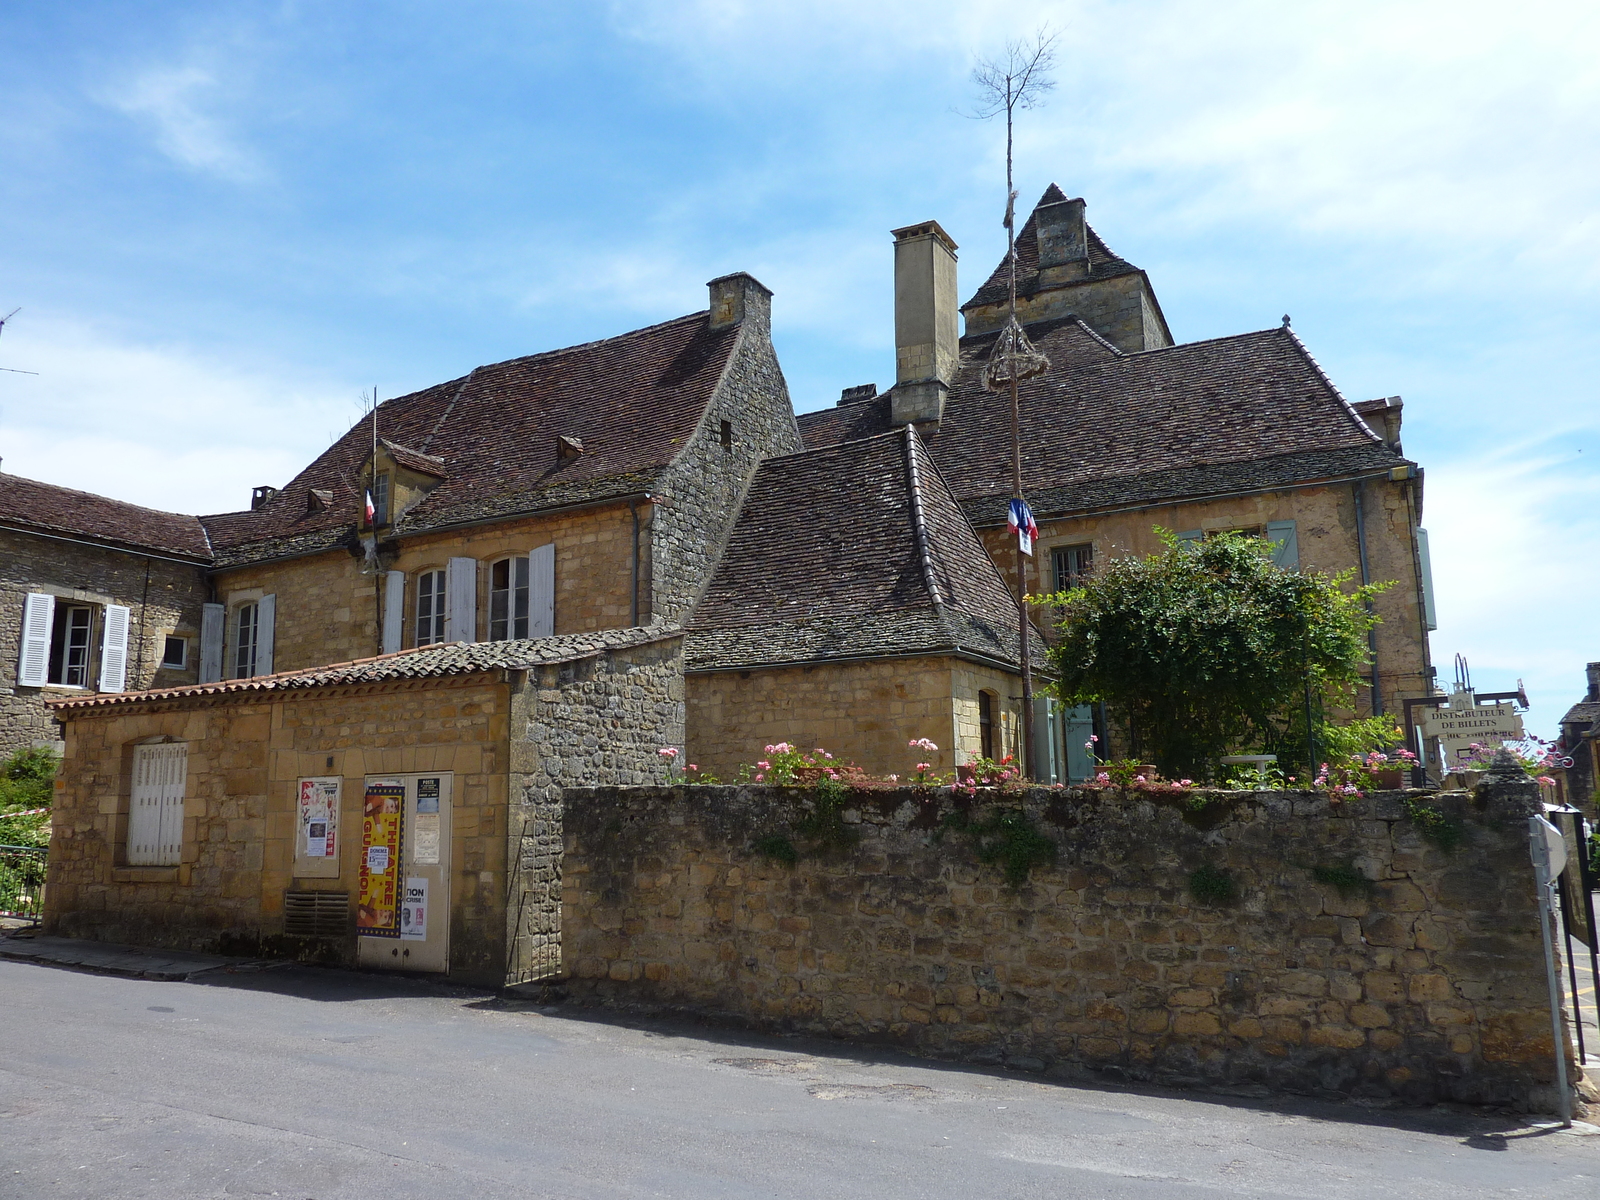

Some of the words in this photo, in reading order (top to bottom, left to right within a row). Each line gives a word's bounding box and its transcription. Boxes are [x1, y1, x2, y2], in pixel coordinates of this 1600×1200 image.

[1441, 721, 1455, 729] DE
[1458, 719, 1497, 728] BILLETS
[359, 820, 372, 900] GUIGNOL
[369, 855, 376, 863] 15
[384, 818, 398, 905] THEATRE
